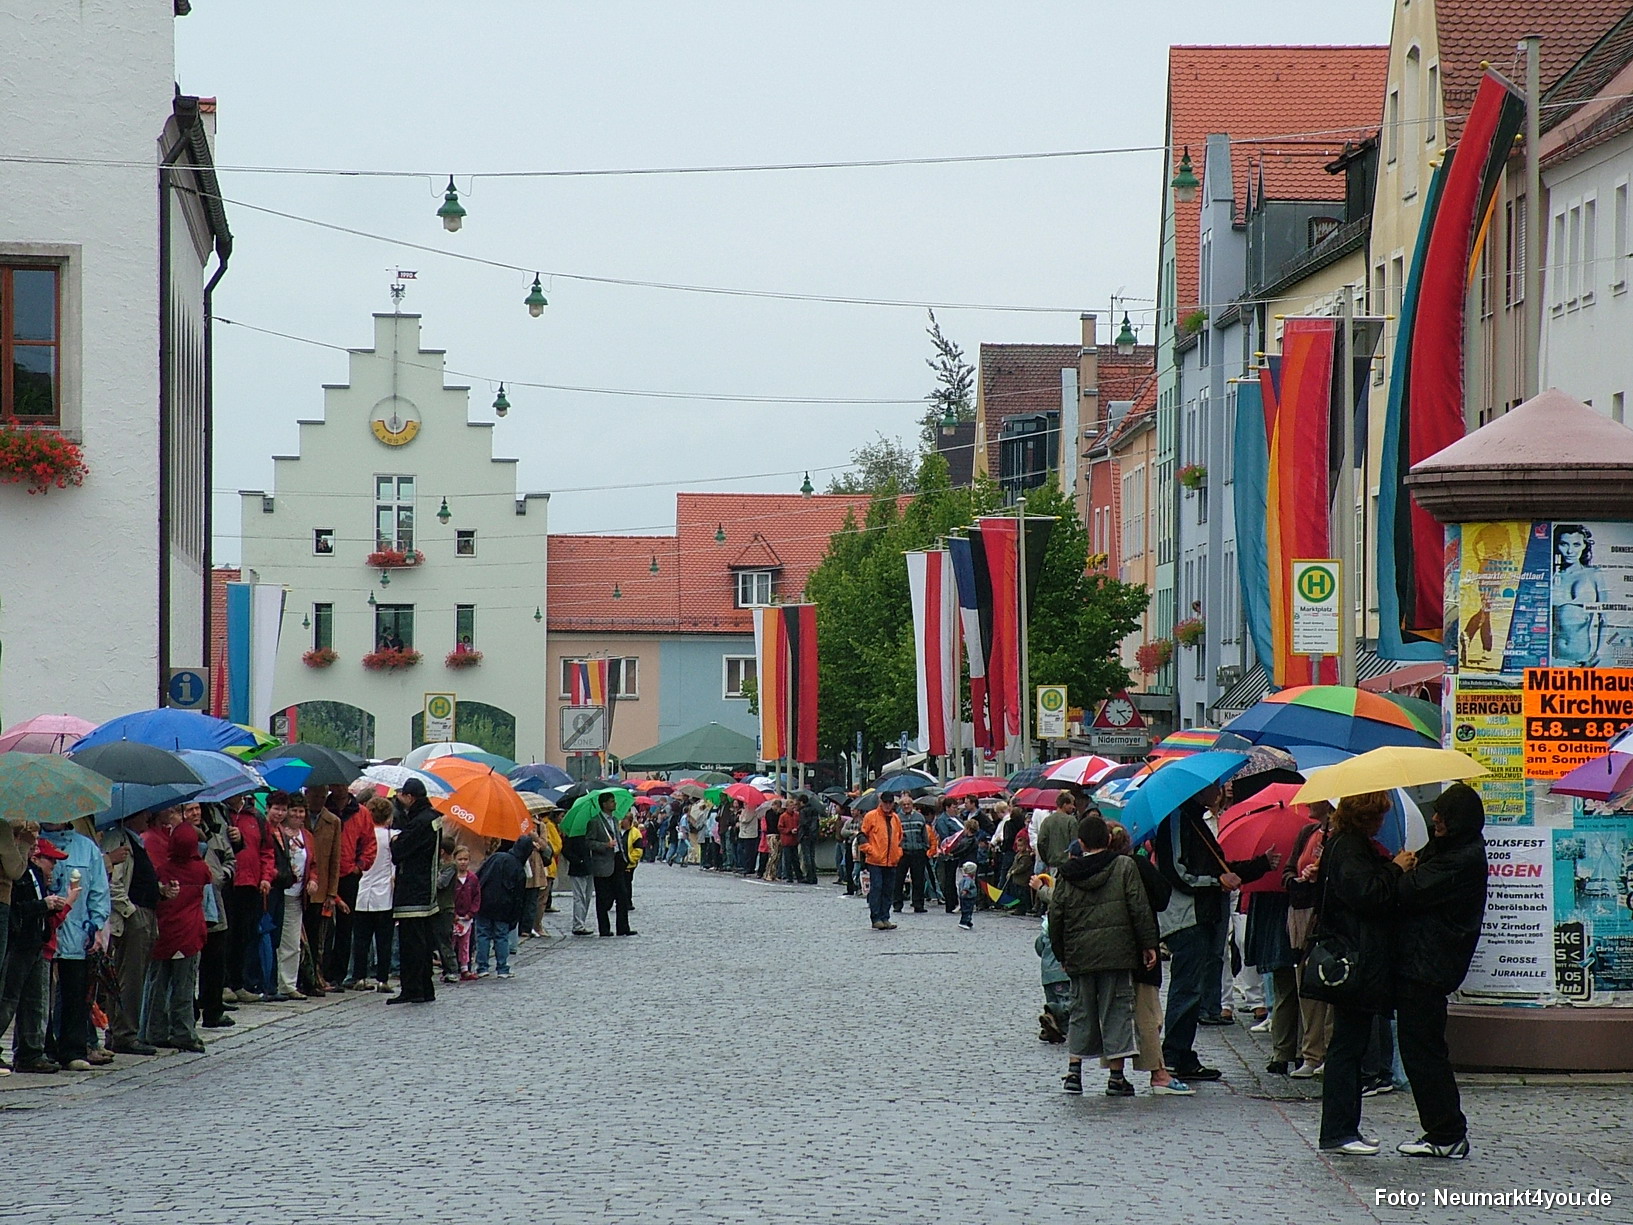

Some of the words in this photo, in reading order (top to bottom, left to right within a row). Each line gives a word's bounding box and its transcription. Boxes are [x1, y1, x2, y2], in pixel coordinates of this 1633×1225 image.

[1308, 575, 1325, 594] H
[1048, 694, 1056, 706] H
[1541, 694, 1633, 715] Kirchwe
[1456, 702, 1522, 714] BERNGAU
[1476, 728, 1523, 737] ROCKNACHT
[1530, 721, 1568, 737] 5.8.
[1098, 736, 1140, 745] Nidermayer
[1480, 747, 1523, 755] STIMMUNG
[1529, 744, 1551, 752] 16.
[1491, 757, 1509, 765] PUR
[1552, 755, 1596, 764] Sonnt
[452, 806, 474, 822] TNT
[1565, 972, 1581, 980] 05
